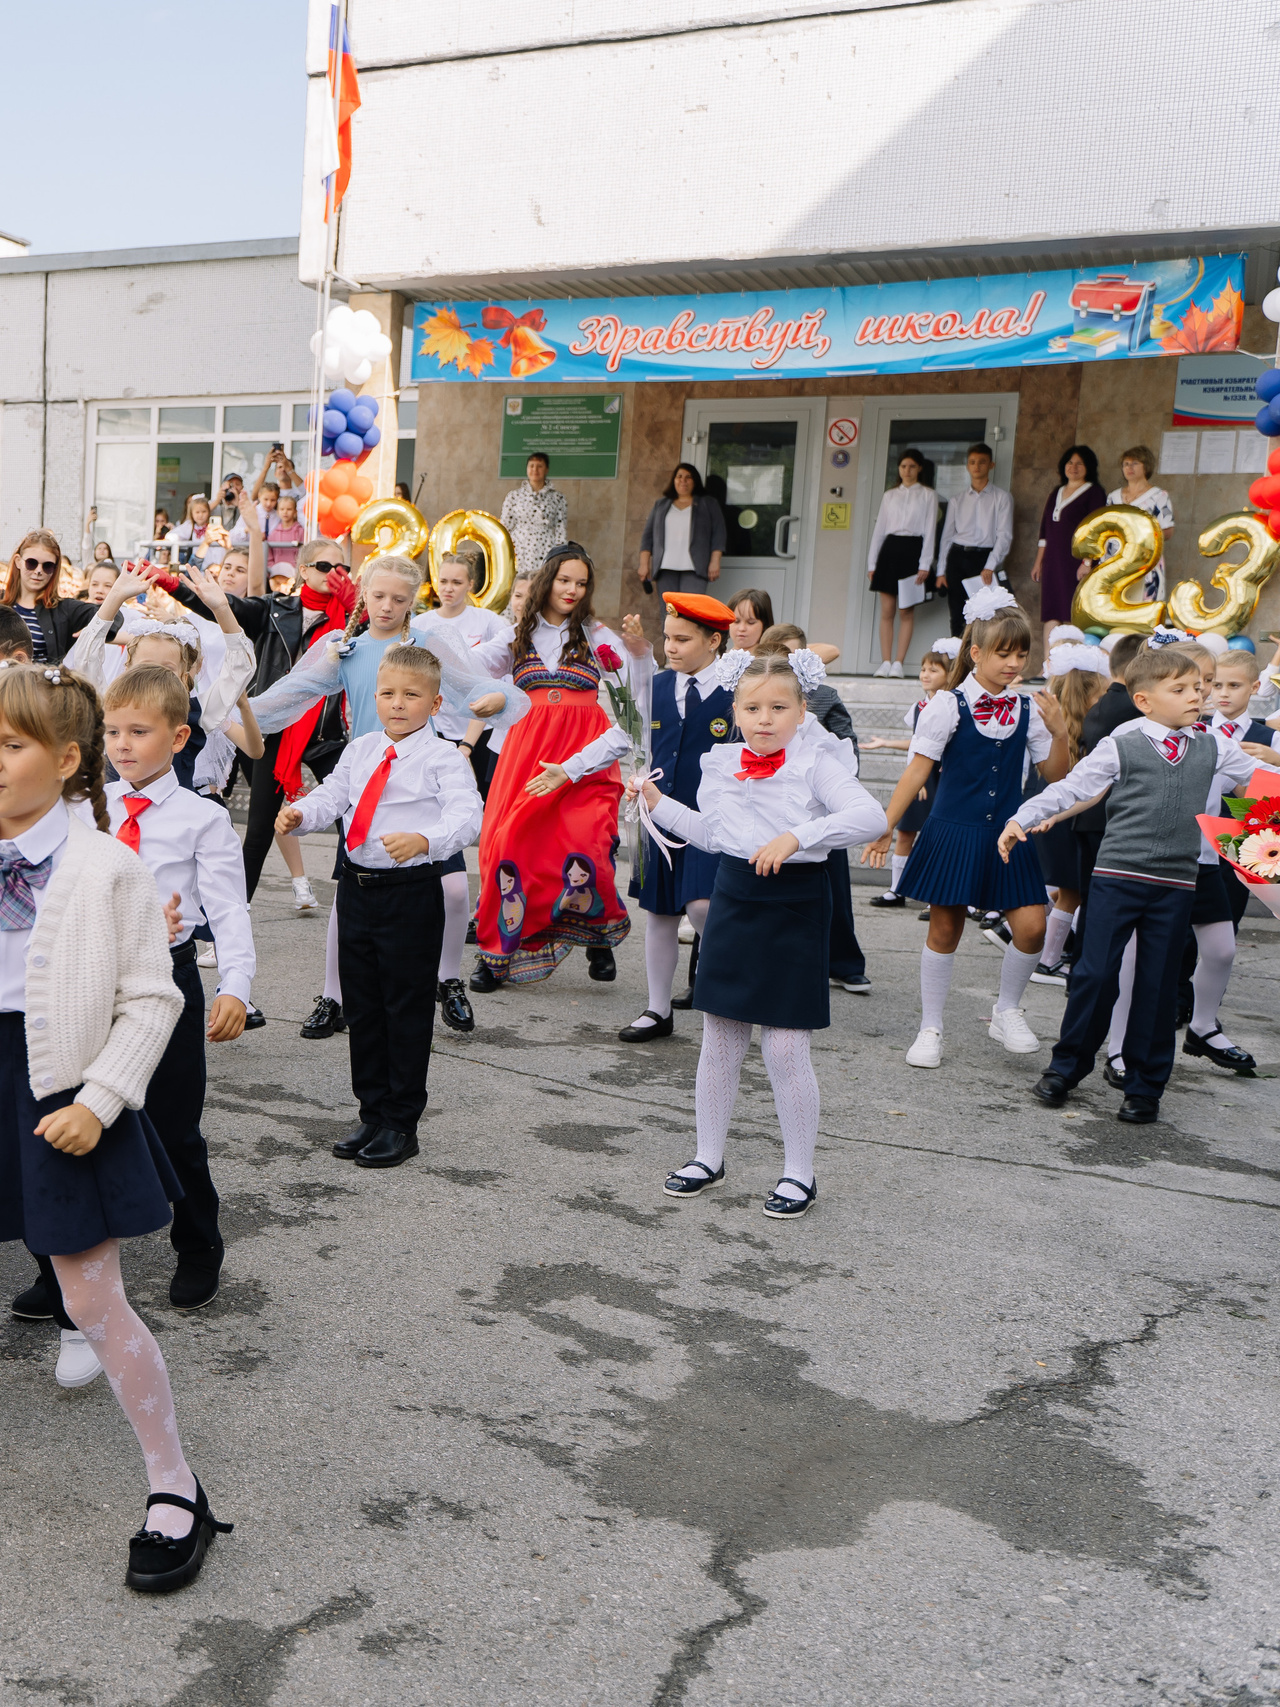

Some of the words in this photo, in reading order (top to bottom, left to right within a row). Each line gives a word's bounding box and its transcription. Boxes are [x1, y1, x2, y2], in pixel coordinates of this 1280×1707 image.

[568, 306, 832, 372] Здравствуй,
[854, 290, 1047, 346] школа!
[1224, 377, 1257, 385] ИЗБИРАТЕ
[1071, 504, 1280, 637] 23
